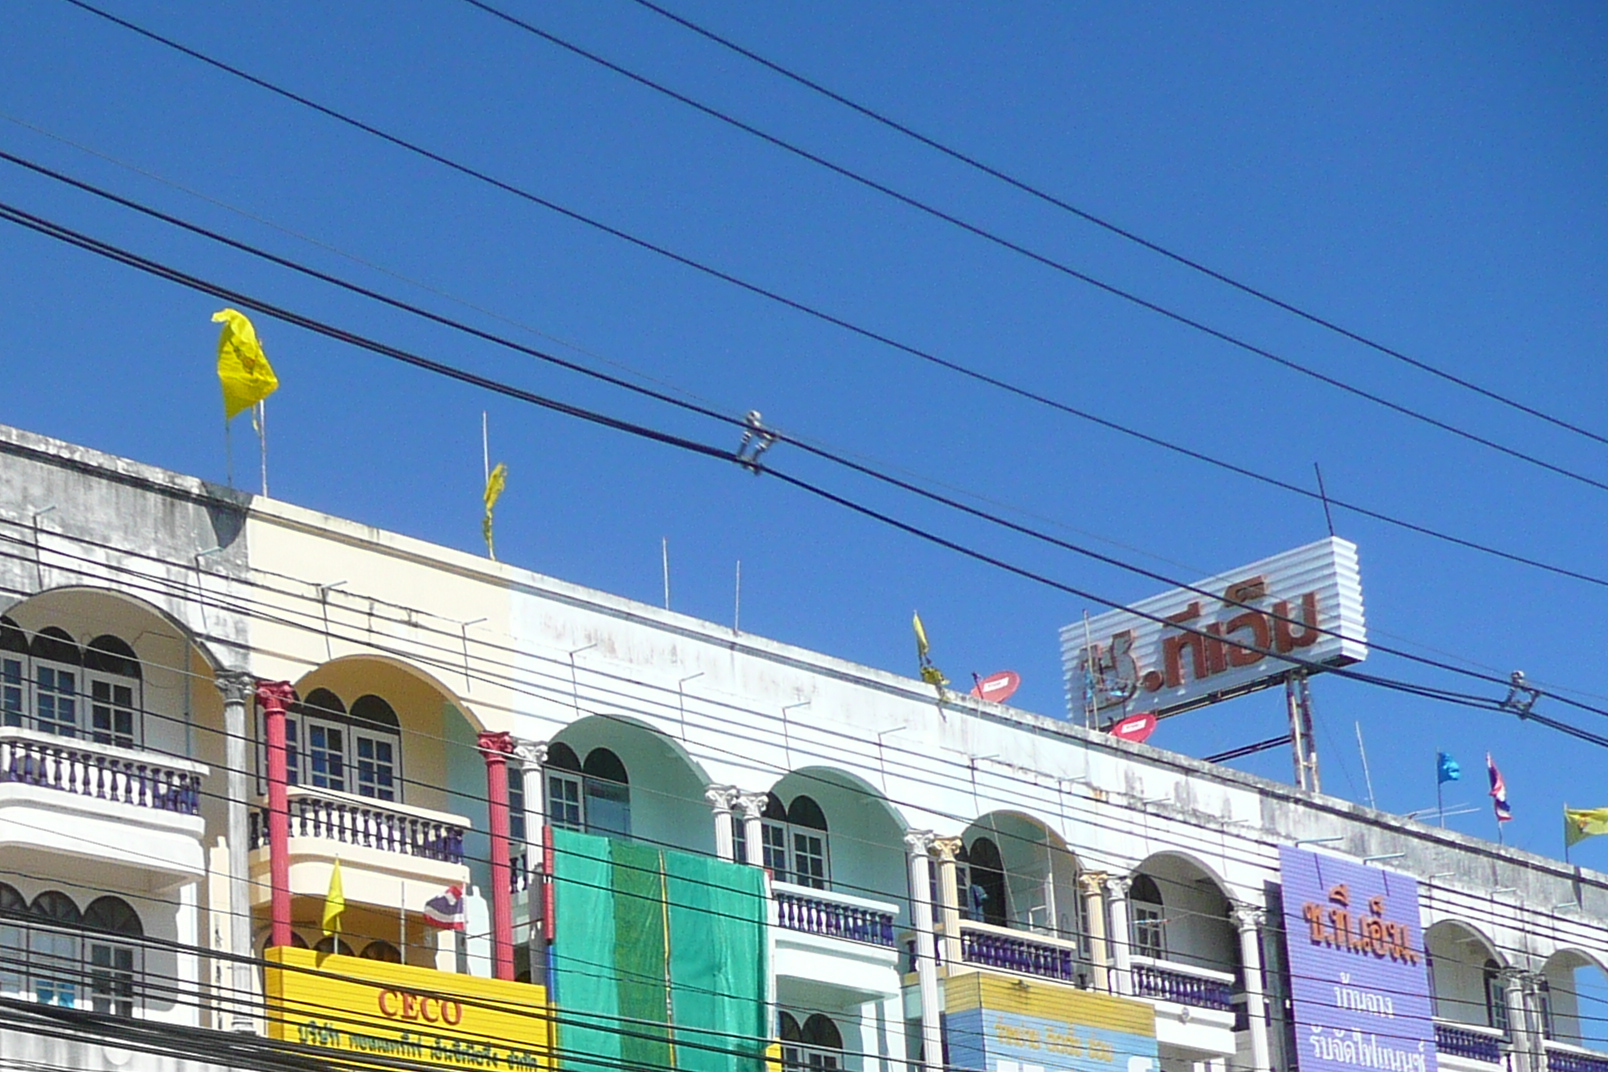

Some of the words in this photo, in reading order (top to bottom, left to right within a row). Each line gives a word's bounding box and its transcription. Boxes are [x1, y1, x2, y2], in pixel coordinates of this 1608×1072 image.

[378, 988, 463, 1026] CECO
[1334, 972, 1394, 1018] บ้านฉาง
[298, 1020, 340, 1047] บริษัท
